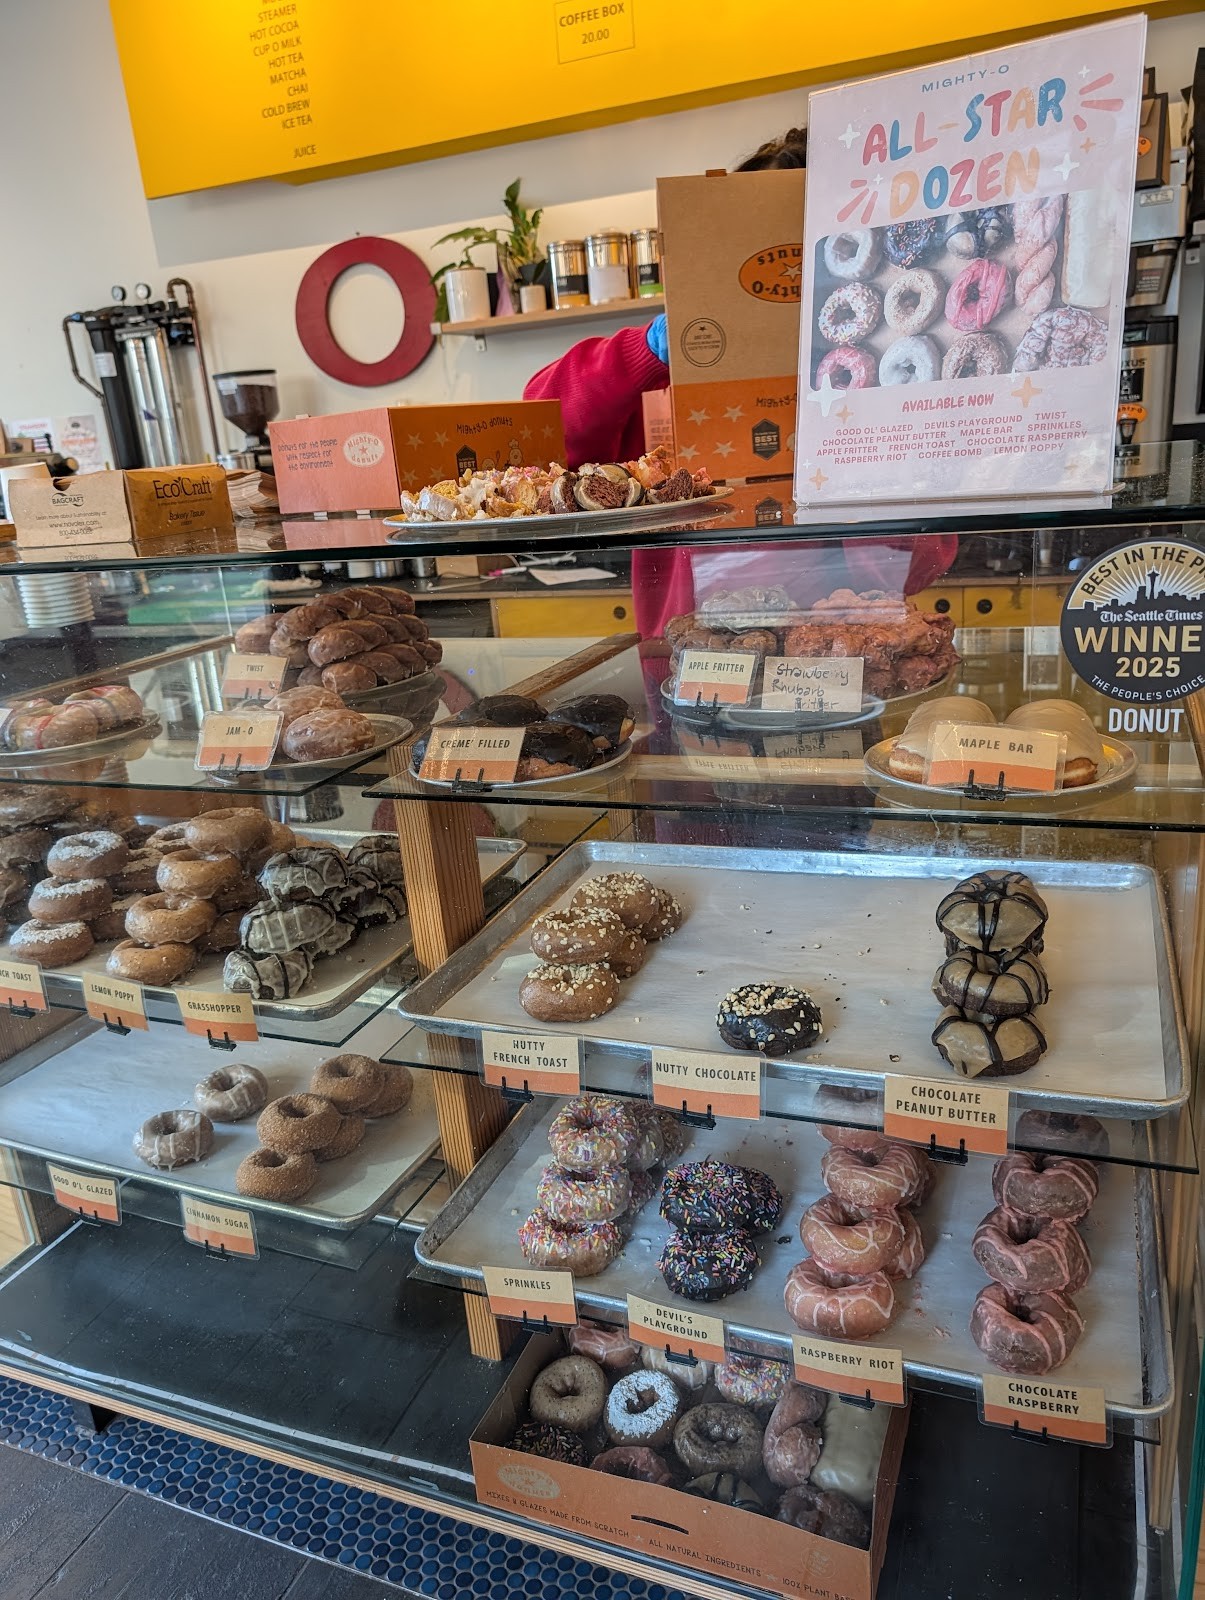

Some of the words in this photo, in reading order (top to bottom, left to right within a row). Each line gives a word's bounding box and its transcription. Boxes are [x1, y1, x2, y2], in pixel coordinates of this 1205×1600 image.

[258, 3, 297, 23] STEAMER
[559, 8, 600, 27] COFFEE
[602, 2, 625, 18] BOX
[249, 28, 266, 41] HOT
[269, 20, 299, 36] COCOA
[581, 28, 610, 45] 20.00
[253, 44, 270, 57] CUP
[281, 36, 302, 49] MILK
[268, 56, 286, 69] HOT
[288, 52, 304, 64] TEA
[270, 67, 307, 85] MATCHA
[921, 64, 1010, 93] MIGHTY-O
[287, 83, 309, 97] CHAI
[262, 104, 285, 118] COLD
[286, 99, 310, 113] BREW
[282, 117, 296, 129] ICE
[296, 114, 312, 126] TEA
[294, 144, 316, 158] JUICE
[890, 146, 1040, 219] DOZEN
[757, 248, 803, 265] nuts
[752, 280, 803, 298] hty-O
[902, 396, 965, 413] AVAILABLE
[967, 393, 995, 408] NOW
[835, 427, 862, 436] GOOD
[880, 424, 914, 433] GLAZED
[924, 420, 956, 430] DEVILS
[957, 414, 1023, 427] PLAYGROUND
[1035, 411, 1068, 420] TWIST
[754, 435, 778, 443] BEST
[817, 448, 842, 456] APPLE
[844, 446, 878, 455] FRITTER
[888, 443, 923, 452] FRENCH
[926, 440, 956, 449] TOAST
[967, 435, 1025, 446] CHOCOLATE
[1028, 430, 1087, 442] RASPBERRY
[822, 437, 874, 447] CHOCOLATE
[876, 433, 910, 443] PEANUT
[912, 430, 947, 441] BUTTER
[960, 428, 991, 437] MAPLE
[993, 426, 1013, 434] BAR
[1027, 420, 1082, 432] SPRINKLES
[834, 454, 884, 464] RASPBERRY
[886, 453, 908, 461] RIOT
[918, 450, 952, 459] COFFEE
[954, 448, 982, 457] BOMB
[994, 445, 1028, 455] LEMON
[1030, 443, 1064, 453] POPPY
[52, 496, 84, 505] BAGCRAFT
[1080, 557, 1120, 596] BEST
[1123, 548, 1145, 566] IN
[1151, 546, 1189, 565] THE
[1100, 610, 1124, 623] The
[1124, 609, 1165, 623] Seattle
[1165, 609, 1204, 622] Times
[1074, 625, 1203, 653] WINNE
[246, 664, 264, 673] TWIST
[688, 661, 709, 671] APPLE
[713, 662, 745, 673] FRITTER
[1115, 656, 1181, 678] 2025
[772, 678, 825, 697] Rhubarb
[1091, 674, 1110, 691] THE
[1111, 686, 1163, 701] PEOPLE'S
[1165, 674, 1205, 699] CHOICE
[1108, 708, 1185, 733] DONUT
[226, 726, 241, 735] JAM
[478, 739, 510, 749] FILLED
[958, 737, 1000, 750] MAPLE
[1008, 742, 1034, 755] BAR
[12, 971, 32, 981] TOAST
[90, 983, 112, 996] LEMON
[114, 989, 135, 1002] POPPY
[187, 1001, 242, 1014] GRASSHOPPER
[513, 1039, 545, 1052] NUTTY
[493, 1051, 530, 1066] FRENCH
[536, 1056, 568, 1068] TOAST
[655, 1061, 689, 1077] NUTTY
[695, 1066, 757, 1082] CHOCOLATE
[911, 1085, 982, 1105] CHOCOLATE
[896, 1099, 944, 1118] PEANUT
[948, 1108, 997, 1124] BUTTER
[53, 1174, 70, 1186] GOOD
[72, 1181, 83, 1190] O'L
[86, 1185, 113, 1196] GLAZED
[186, 1206, 221, 1224] CINNAMON
[224, 1217, 249, 1230] SUGAR
[504, 1277, 551, 1290] SPRINKLES
[656, 1308, 693, 1324] DEVIL'S
[643, 1316, 708, 1340] PLAYGROUND
[800, 1345, 862, 1367] RASPBERRY
[869, 1358, 895, 1371] RIOT
[1008, 1382, 1078, 1401] CHOCOLATE
[1008, 1395, 1080, 1415] RASPBERRY
[486, 1491, 510, 1503] MIXES
[520, 1500, 547, 1514] GLAZES
[550, 1508, 569, 1520] MADE
[572, 1516, 591, 1527] FROM
[594, 1521, 629, 1538] SCRATCH
[649, 1539, 663, 1548] ALL
[666, 1543, 702, 1559] NATURAL
[705, 1553, 762, 1578] INGREDIENTS
[804, 1583, 831, 1598] PLANT
